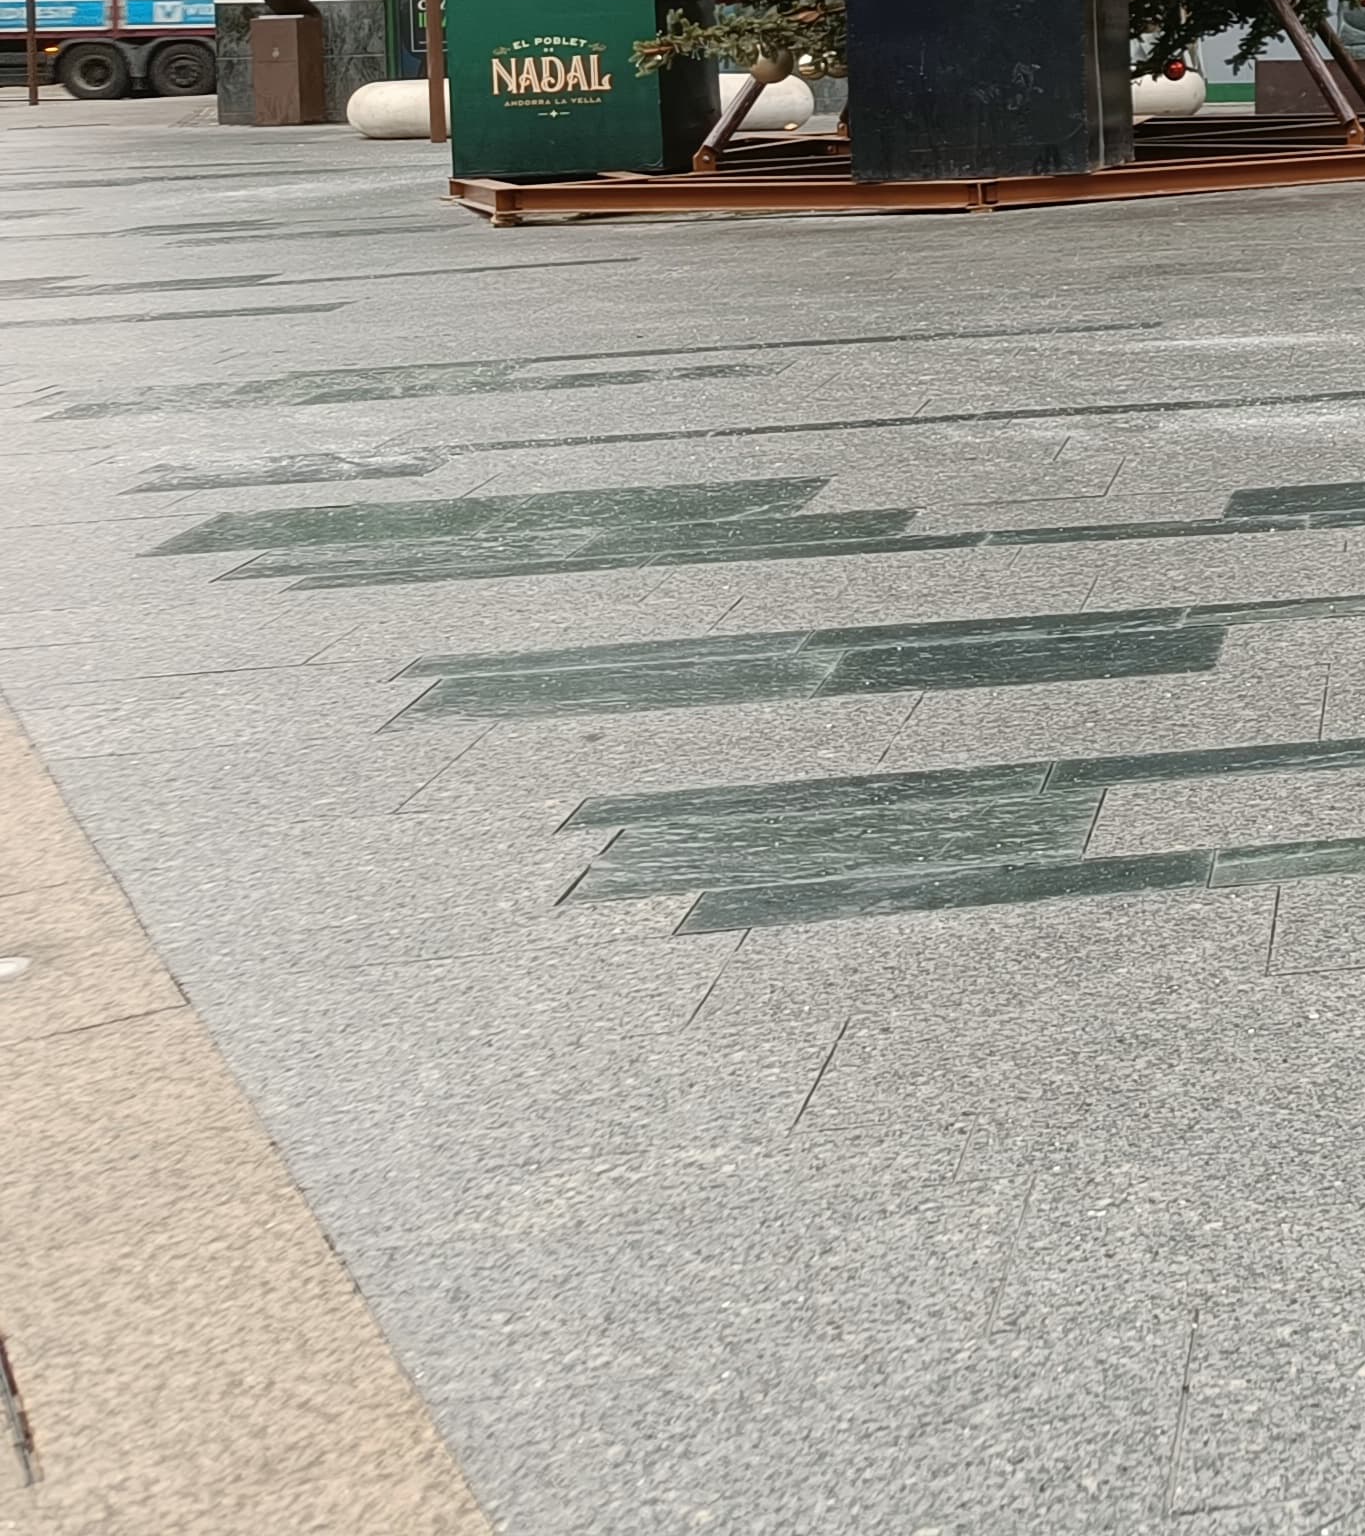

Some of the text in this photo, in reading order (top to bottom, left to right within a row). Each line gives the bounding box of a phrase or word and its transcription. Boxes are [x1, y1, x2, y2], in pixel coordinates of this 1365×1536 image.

[512, 36, 588, 50] EL POBLET
[491, 54, 612, 95] NADAL
[504, 99, 551, 107] ANDORRA
[570, 96, 602, 104] VELLA
